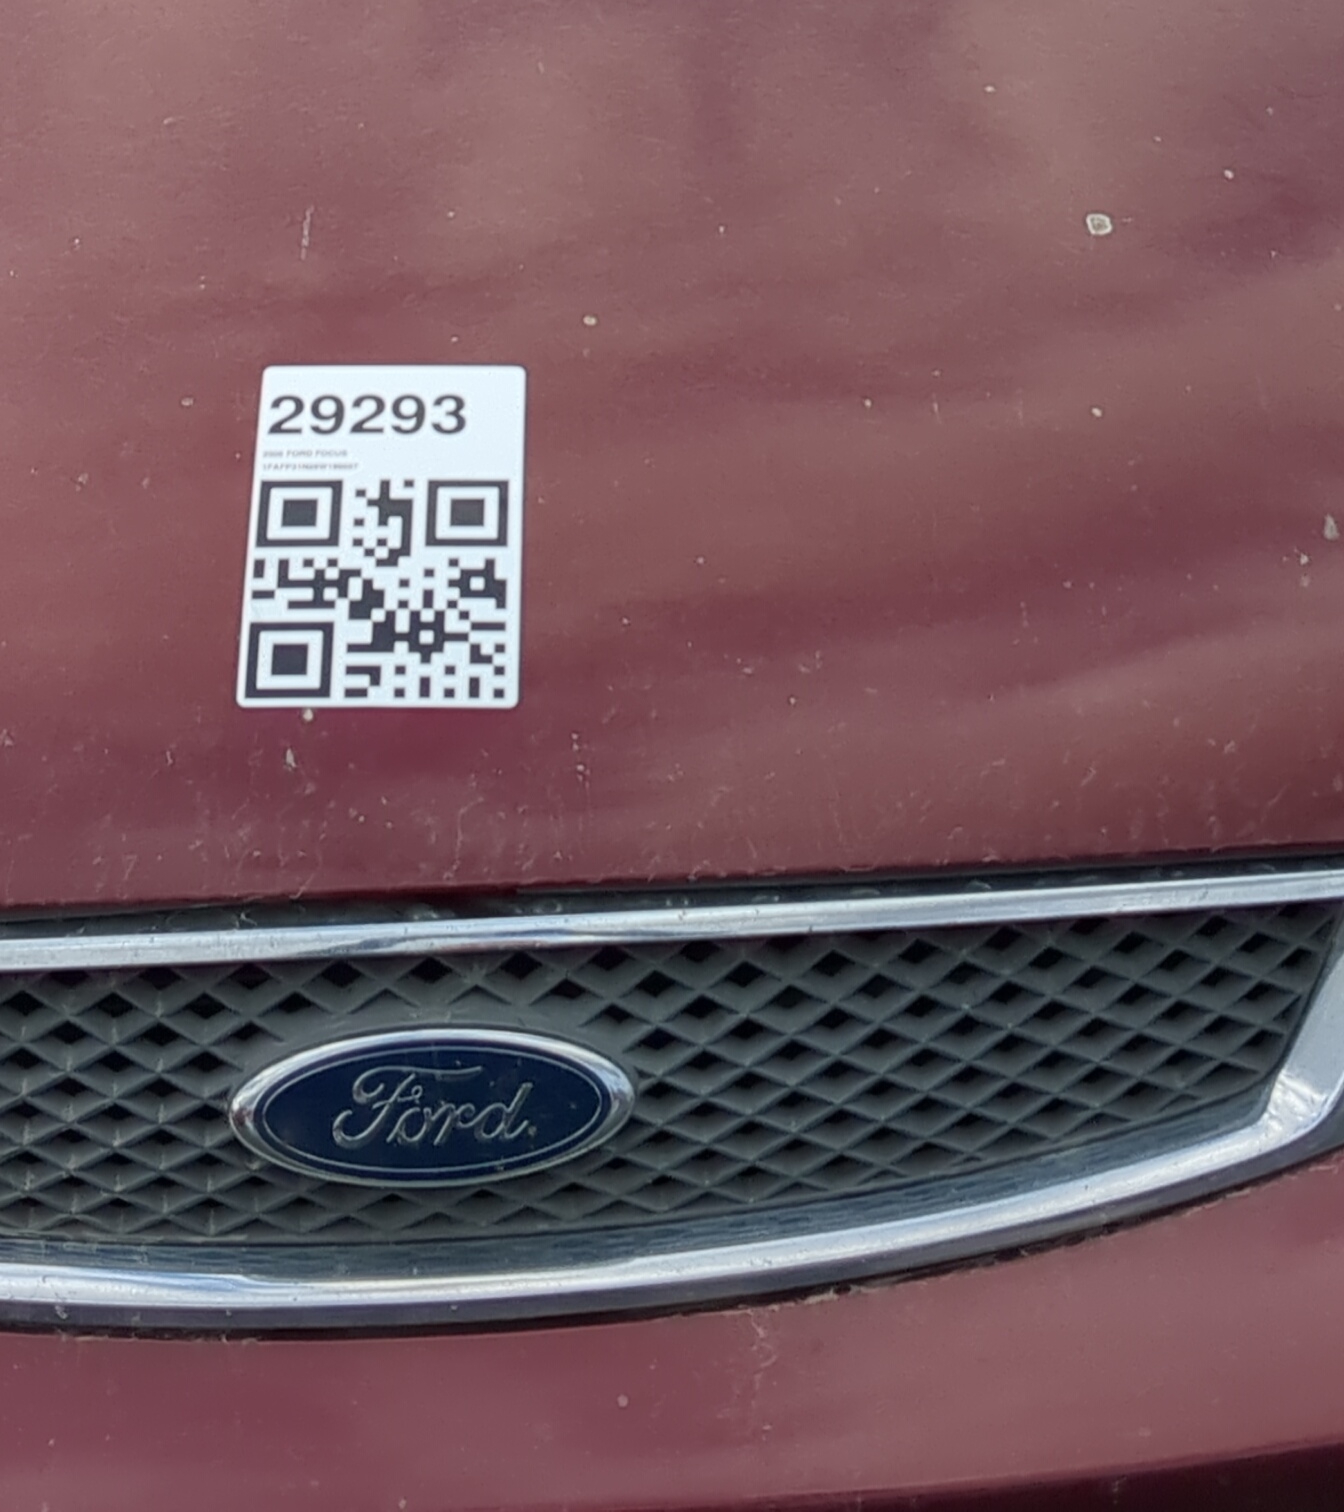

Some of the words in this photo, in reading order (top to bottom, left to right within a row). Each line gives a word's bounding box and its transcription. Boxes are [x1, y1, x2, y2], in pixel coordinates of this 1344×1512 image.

[266, 394, 468, 436] 29293
[286, 449, 314, 458] FORD
[315, 449, 349, 458] FOCUS
[332, 1063, 536, 1149] Ford
